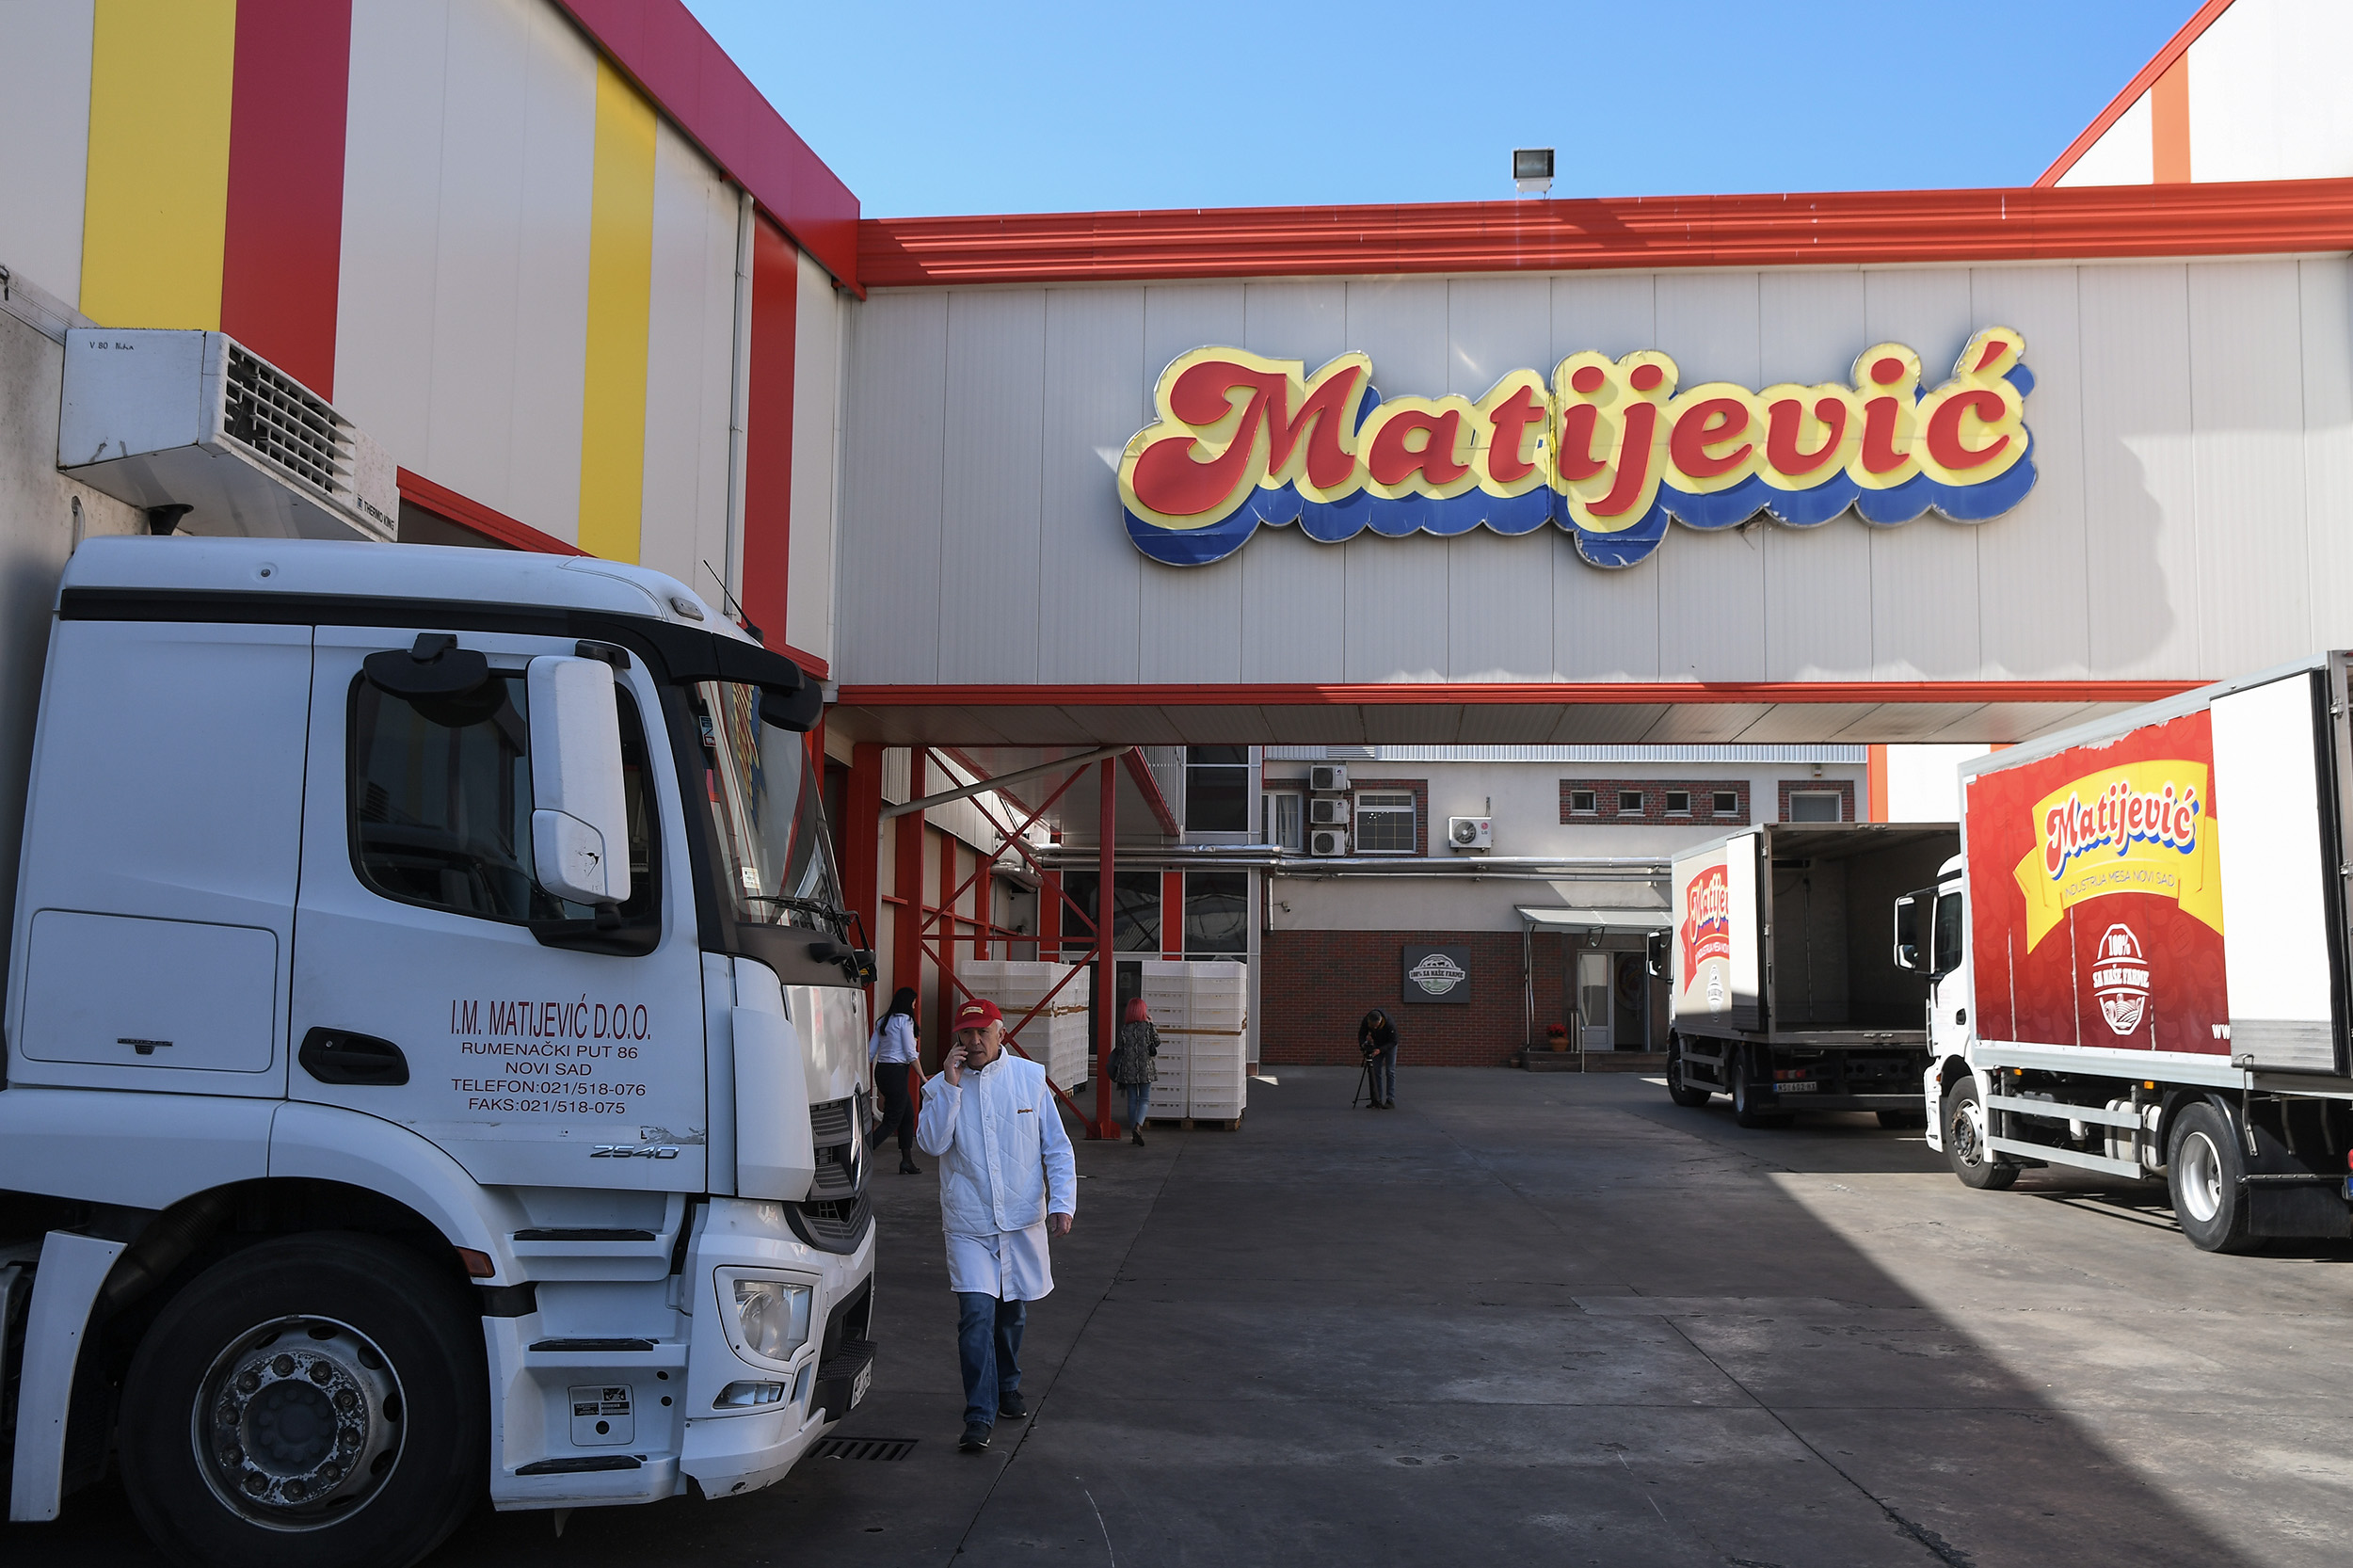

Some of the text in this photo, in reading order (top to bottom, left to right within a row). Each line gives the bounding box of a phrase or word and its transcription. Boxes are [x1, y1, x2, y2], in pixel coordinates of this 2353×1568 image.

[1127, 334, 2019, 532] Matijević
[364, 501, 394, 531] THERMO KING
[2045, 780, 2196, 875] Matijević
[2109, 870, 2131, 883] MESA
[2133, 870, 2154, 884] NOVI
[2156, 872, 2176, 888] SAD
[2107, 933, 2132, 957] 100%
[451, 993, 651, 1040] I.M. MATIJEVIĆ D.O.O.
[461, 1041, 638, 1059] RUMENAČKI PUT 86
[505, 1062, 593, 1076] NOVI SAD
[451, 1079, 647, 1096] TELEFON:021/518-076
[468, 1097, 626, 1114] FAKS:021/518-075
[589, 1144, 680, 1160] 2540
